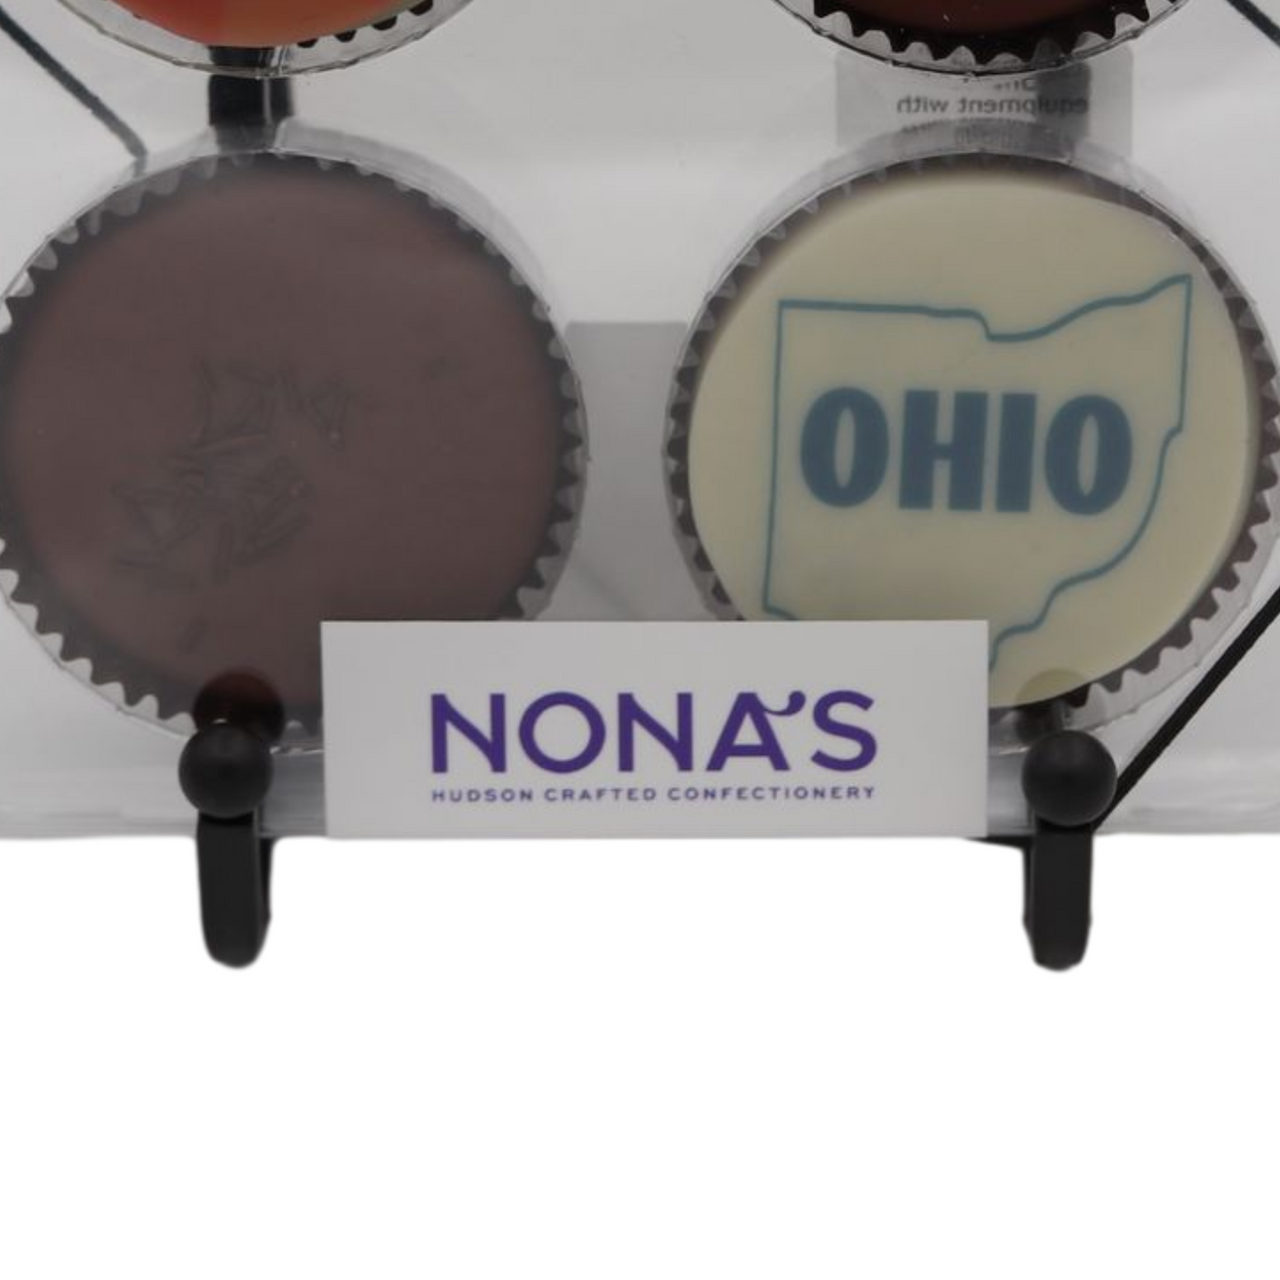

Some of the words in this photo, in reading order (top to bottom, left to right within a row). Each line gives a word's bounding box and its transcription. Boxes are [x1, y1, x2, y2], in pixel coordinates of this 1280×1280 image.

[799, 386, 1133, 515] OHIO
[430, 690, 878, 774] NONA'S
[432, 788, 533, 803] HUDSON
[543, 787, 657, 802] CRAFTED
[667, 786, 875, 801] CONFECTIONERY
